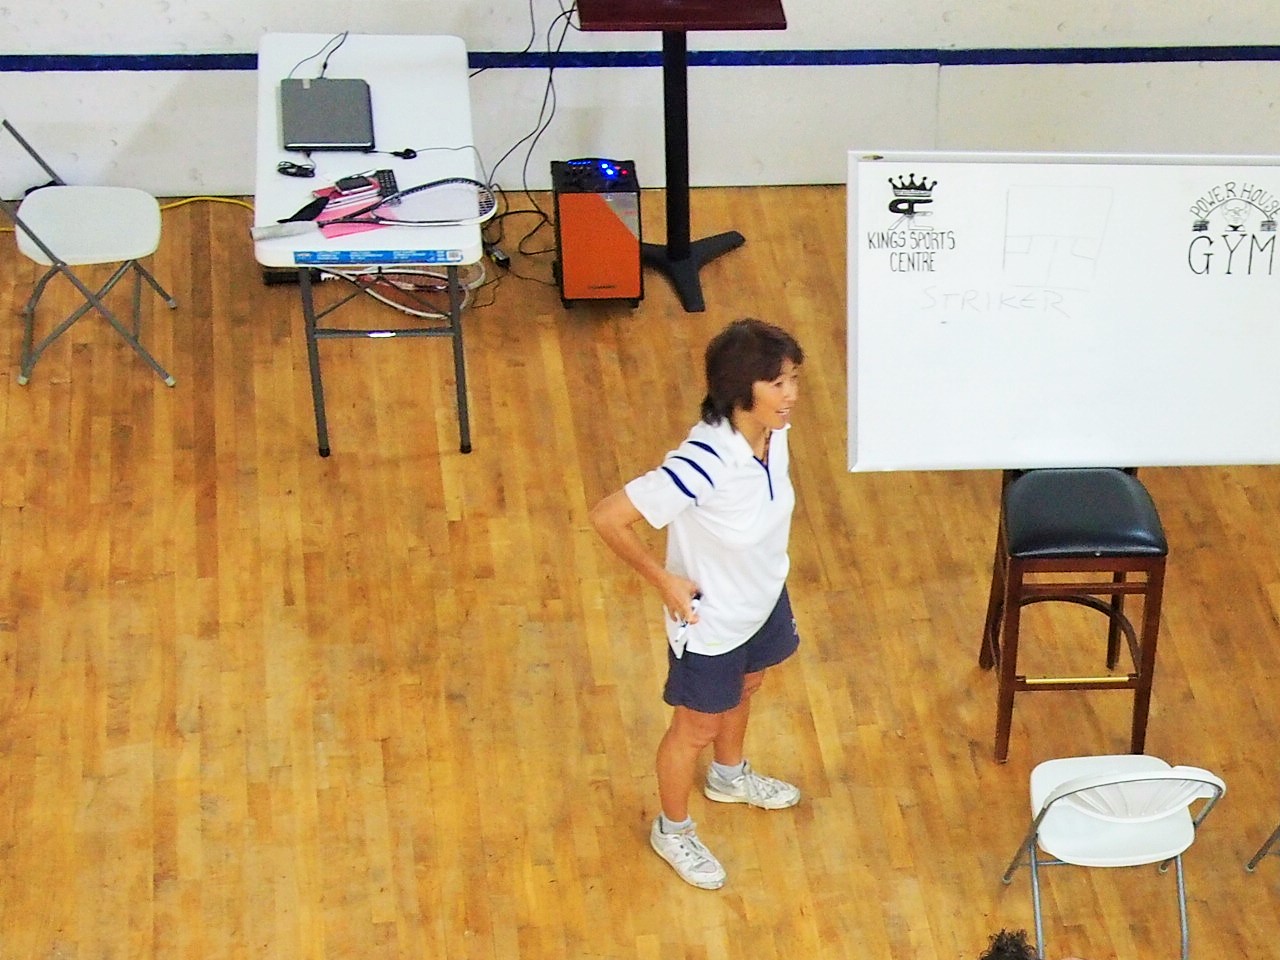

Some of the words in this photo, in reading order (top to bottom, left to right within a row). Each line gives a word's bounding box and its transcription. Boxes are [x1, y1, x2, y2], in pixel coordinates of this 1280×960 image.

[1189, 181, 1237, 219] POWER
[867, 231, 906, 249] KINGS
[909, 230, 956, 250] SPORTS
[1188, 233, 1277, 275] GYM
[889, 251, 936, 272] CENTRE
[920, 285, 1071, 318] STRIKER
